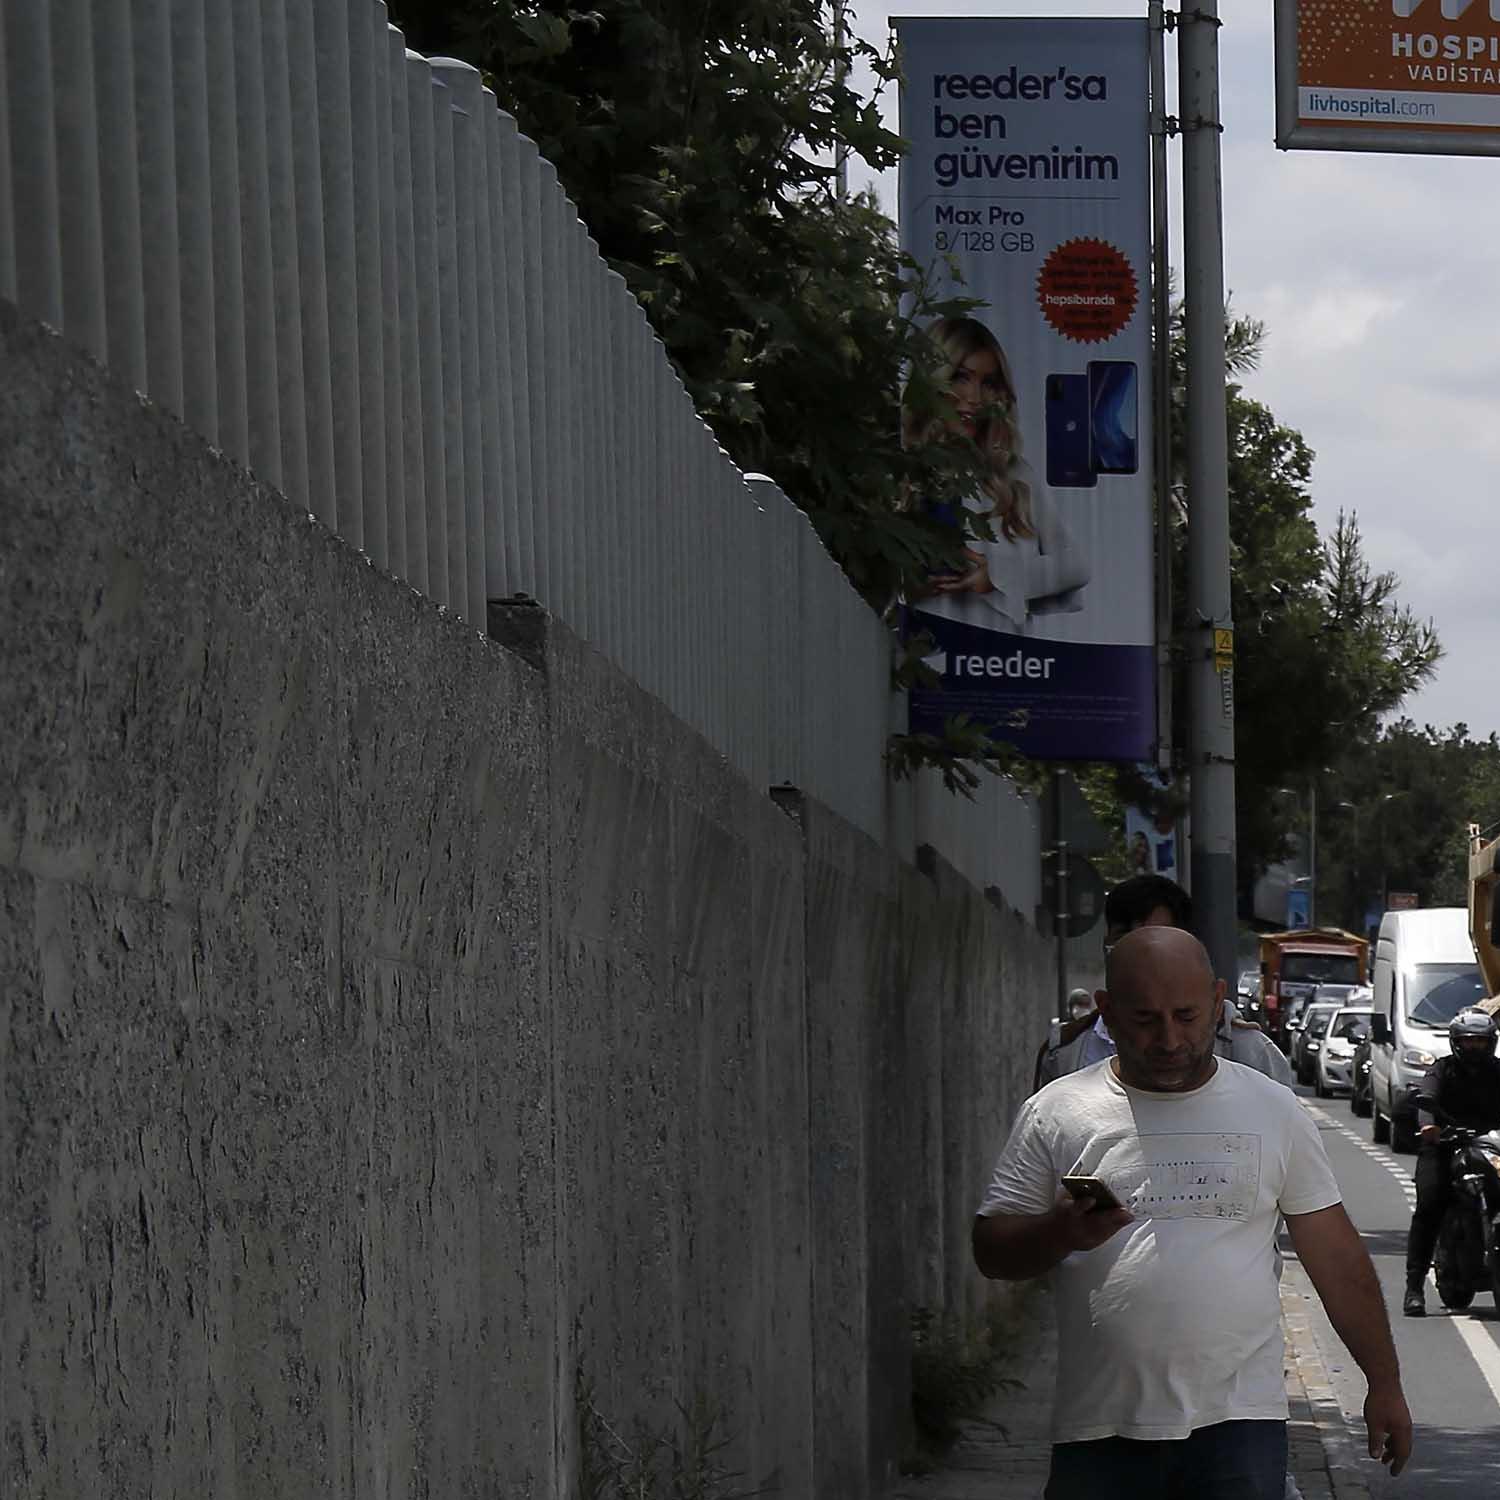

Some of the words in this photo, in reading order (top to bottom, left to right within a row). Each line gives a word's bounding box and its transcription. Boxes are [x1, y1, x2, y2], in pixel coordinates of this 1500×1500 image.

[933, 66, 1106, 100] reeder'sa
[1309, 94, 1436, 118] livhospital.com
[934, 105, 1006, 139] ben
[933, 145, 1119, 187] güvenirim
[935, 205, 982, 225] Max
[988, 206, 1025, 226] Pro
[935, 231, 995, 252] 8/128
[1001, 232, 1035, 252] GB
[1045, 294, 1116, 306] hepsiburada
[955, 650, 1056, 679] reeder
